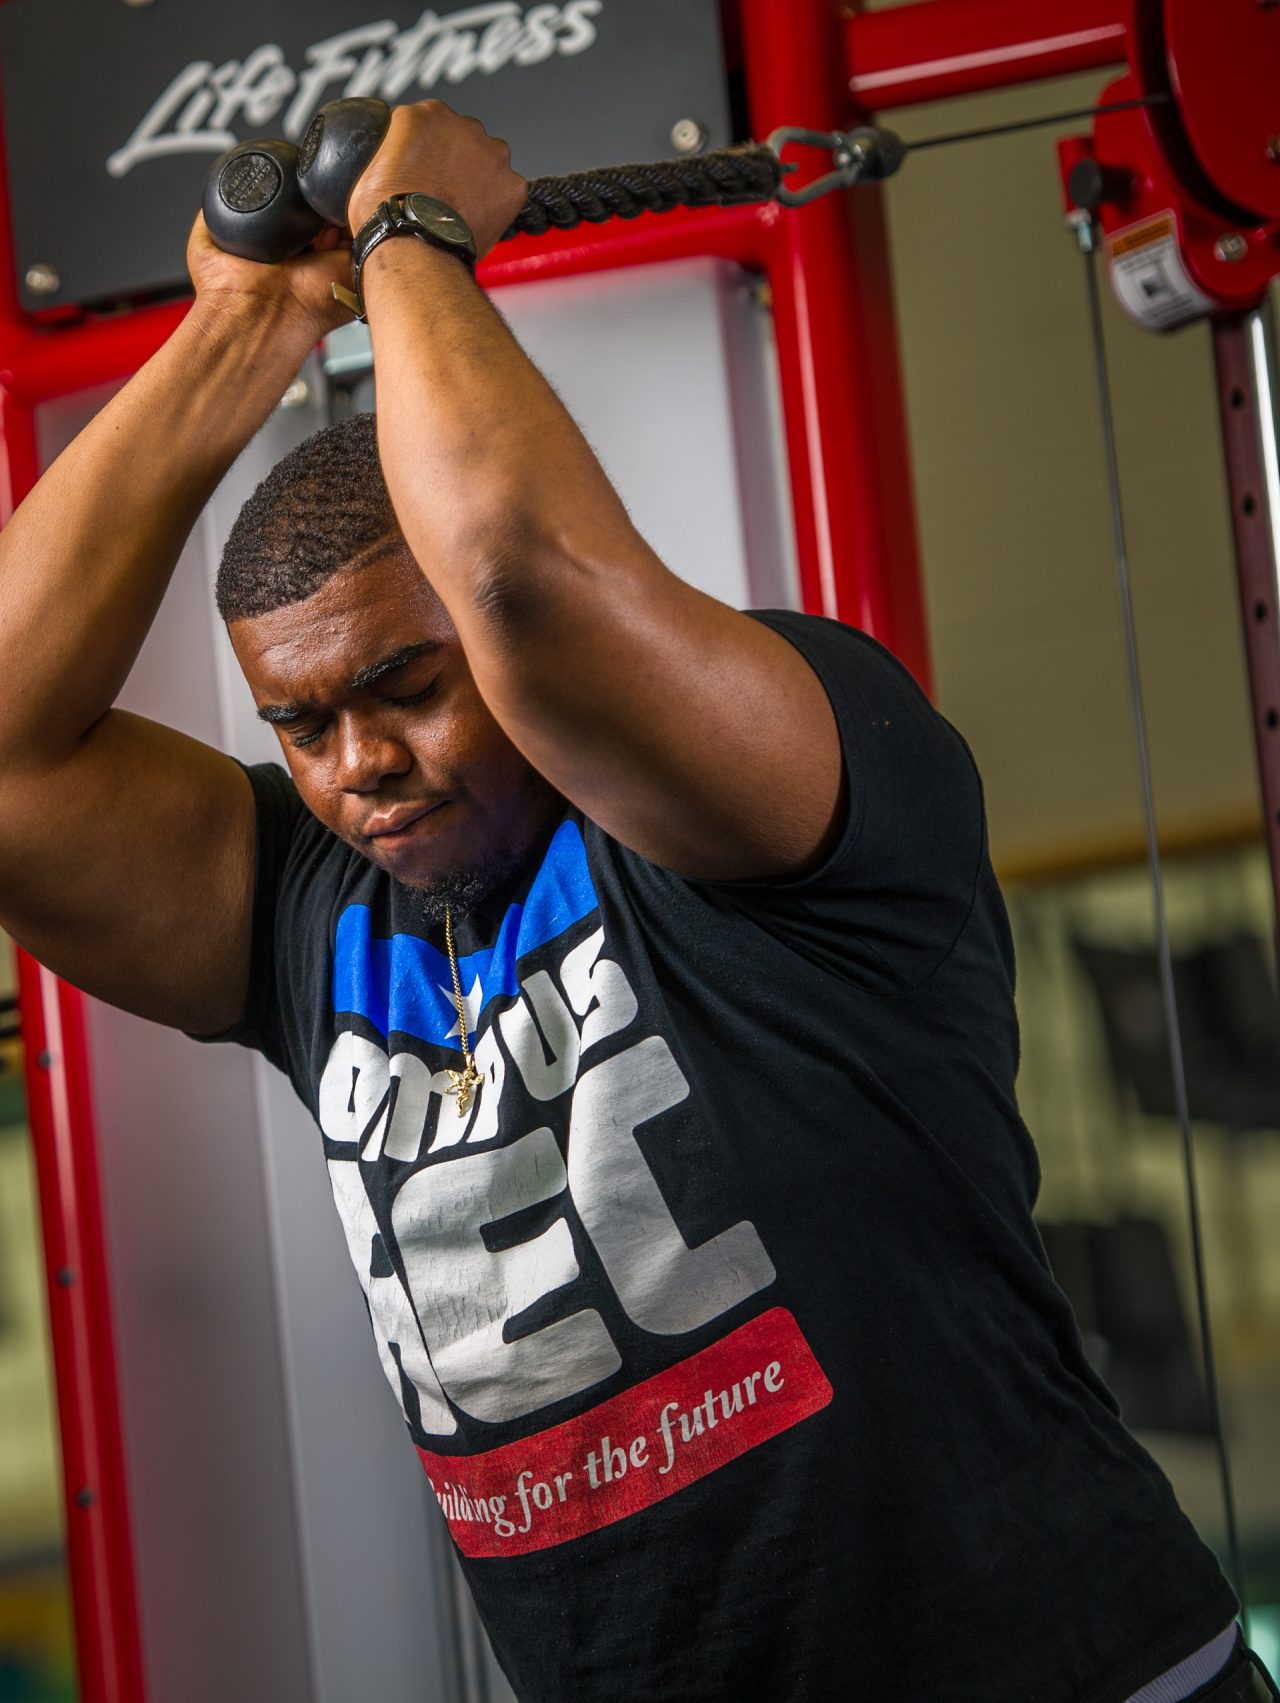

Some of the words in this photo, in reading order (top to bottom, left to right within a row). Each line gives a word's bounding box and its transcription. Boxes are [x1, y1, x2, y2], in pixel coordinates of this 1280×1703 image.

[428, 1477, 515, 1537] uilding
[514, 1471, 573, 1534] for
[582, 1435, 650, 1489] the
[656, 1360, 786, 1474] future
